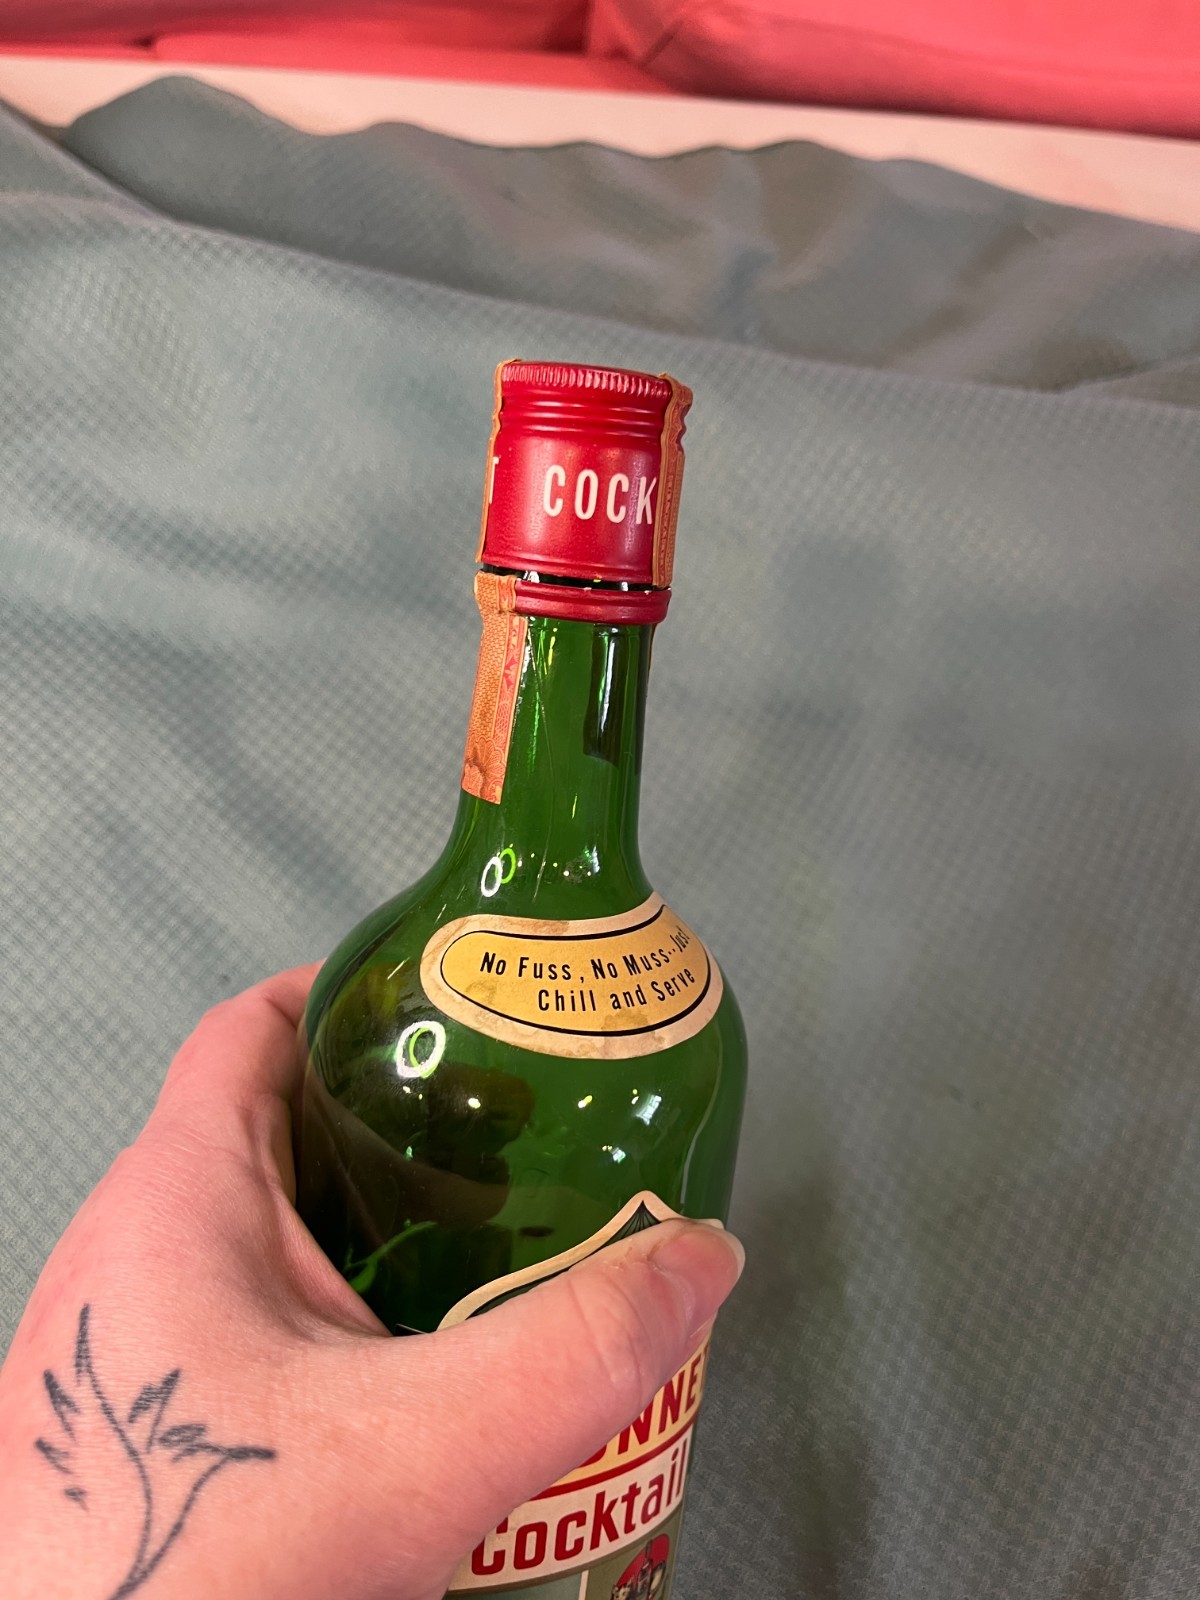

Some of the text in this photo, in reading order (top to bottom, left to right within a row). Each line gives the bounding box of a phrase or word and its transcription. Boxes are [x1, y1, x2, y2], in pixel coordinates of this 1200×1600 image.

[480, 951, 506, 977] No
[517, 956, 585, 984] Fuss,
[590, 958, 619, 981] No
[538, 967, 696, 1012] Chill and Serve
[471, 1437, 689, 1577] Cocktail
